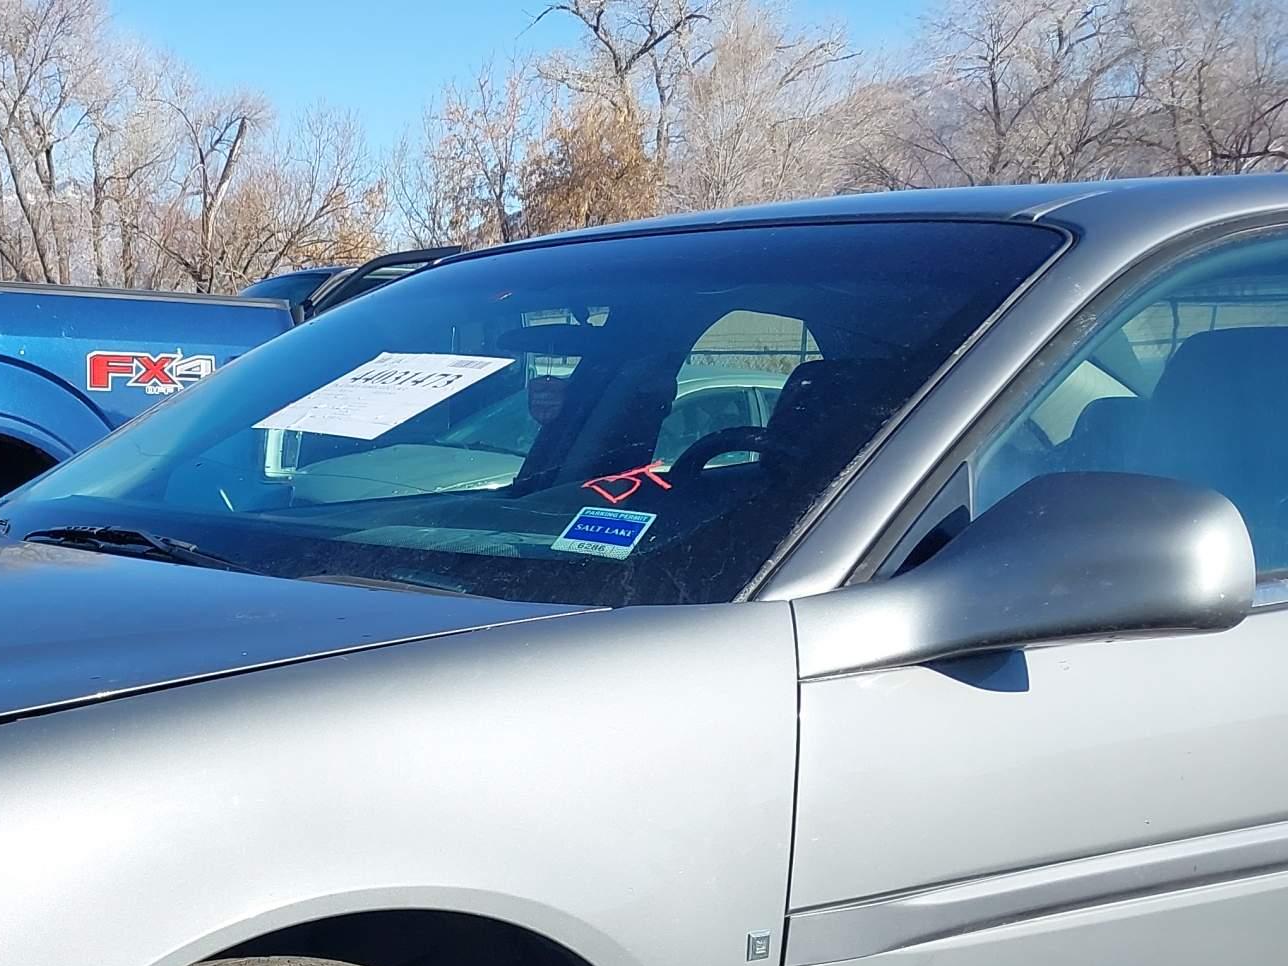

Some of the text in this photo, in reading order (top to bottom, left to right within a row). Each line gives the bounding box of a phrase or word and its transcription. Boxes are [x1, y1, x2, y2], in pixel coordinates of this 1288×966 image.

[87, 350, 216, 392] FX4
[350, 368, 463, 389] 44031473
[585, 510, 650, 522] PARKING PERMIT
[574, 523, 636, 537] SALT LAKE
